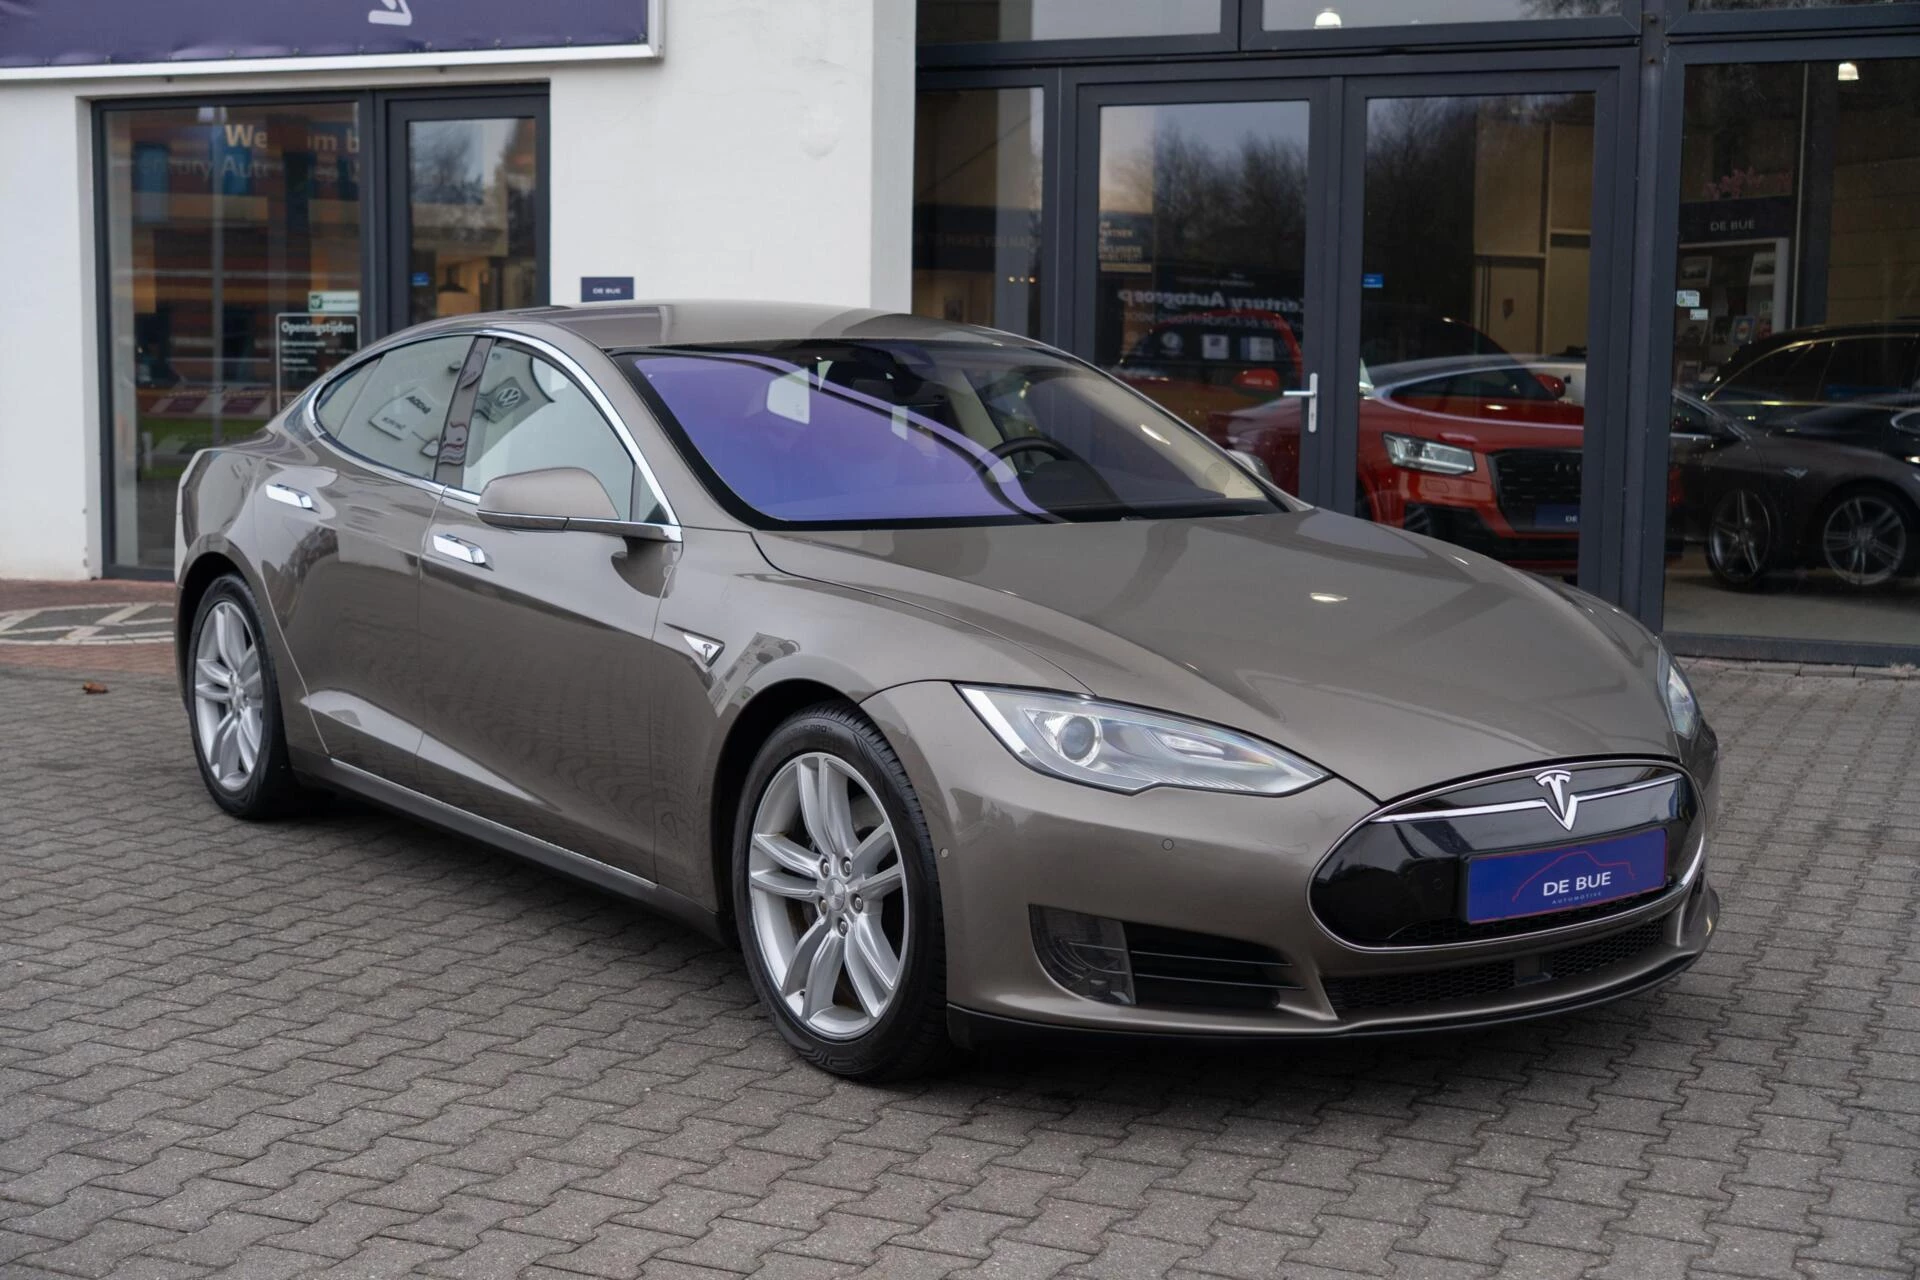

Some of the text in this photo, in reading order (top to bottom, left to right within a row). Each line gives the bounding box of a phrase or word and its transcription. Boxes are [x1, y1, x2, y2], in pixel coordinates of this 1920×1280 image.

[1710, 221, 1727, 232] DE
[281, 321, 355, 336] Openingstijden
[1543, 871, 1612, 897] DE BUE
[1552, 891, 1602, 905] AUTOMOTIVE
